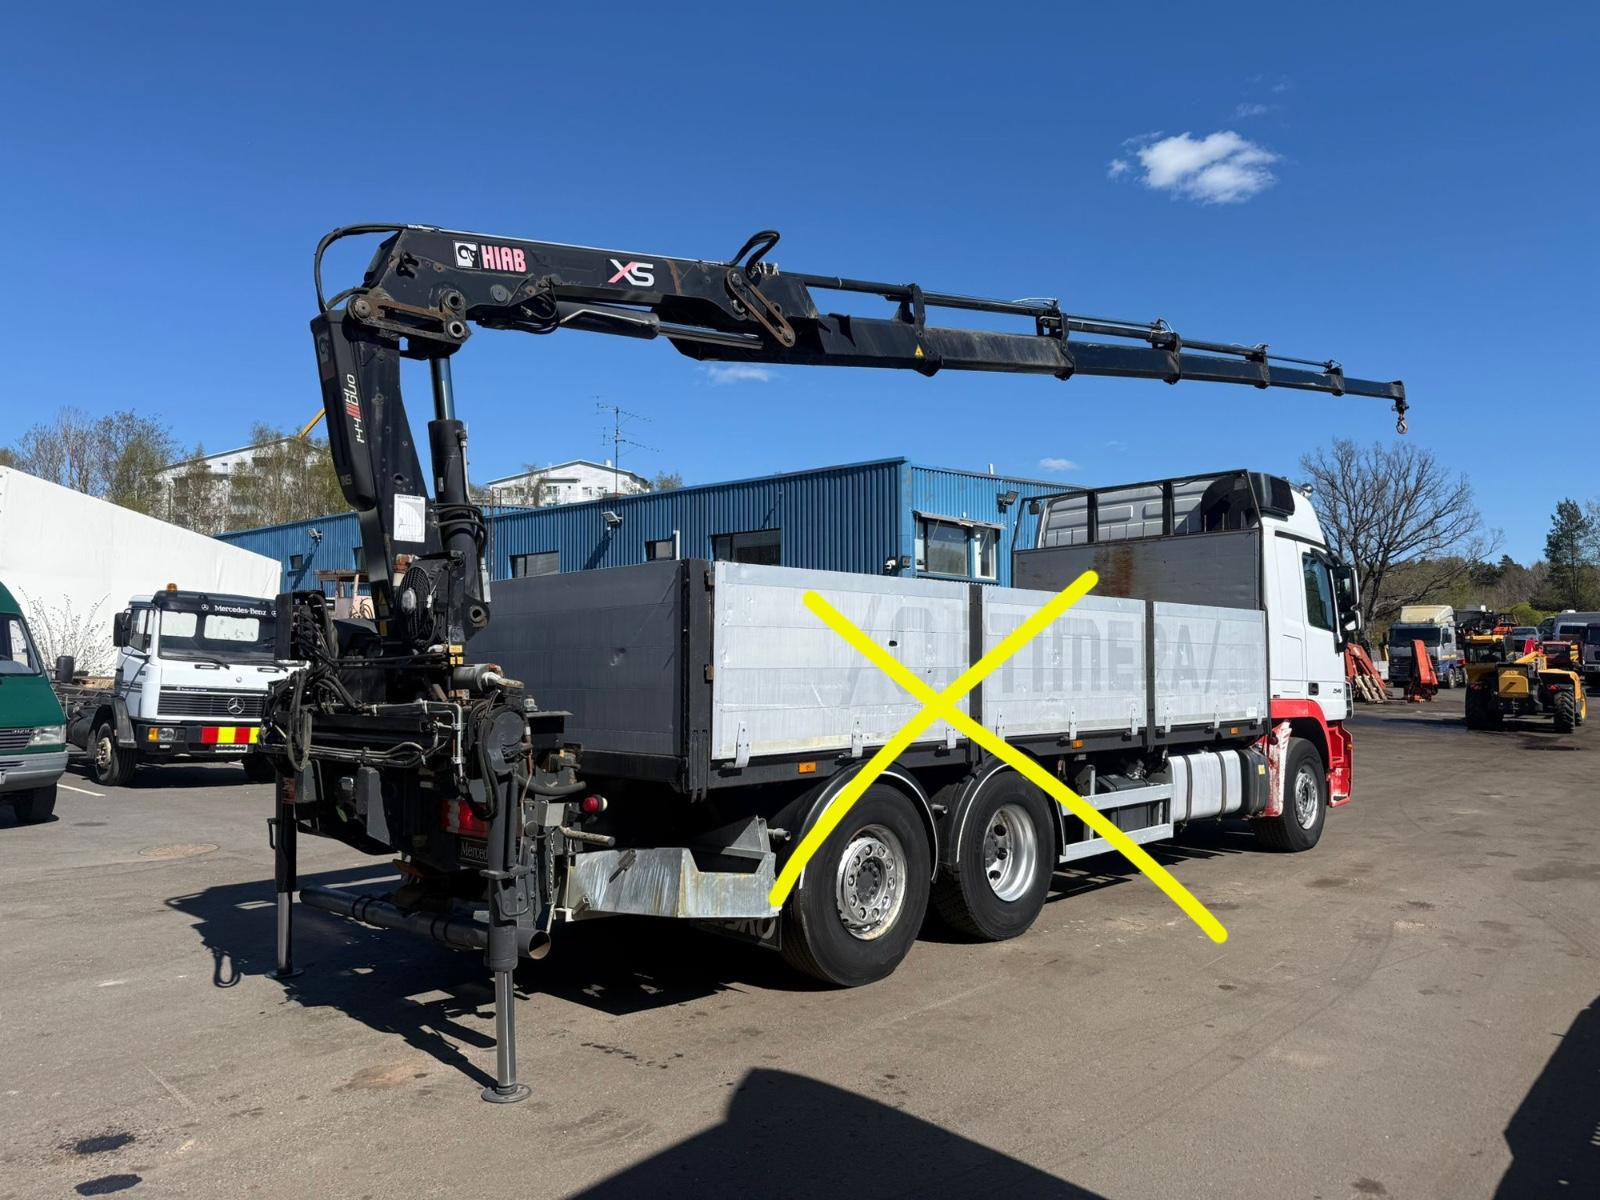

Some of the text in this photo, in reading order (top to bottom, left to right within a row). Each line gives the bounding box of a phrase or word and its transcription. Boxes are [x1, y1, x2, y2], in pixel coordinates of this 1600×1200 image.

[481, 245, 527, 272] HIAB
[608, 259, 655, 287] XS
[353, 417, 365, 444] 144
[214, 605, 267, 616] Mercedes-Benz
